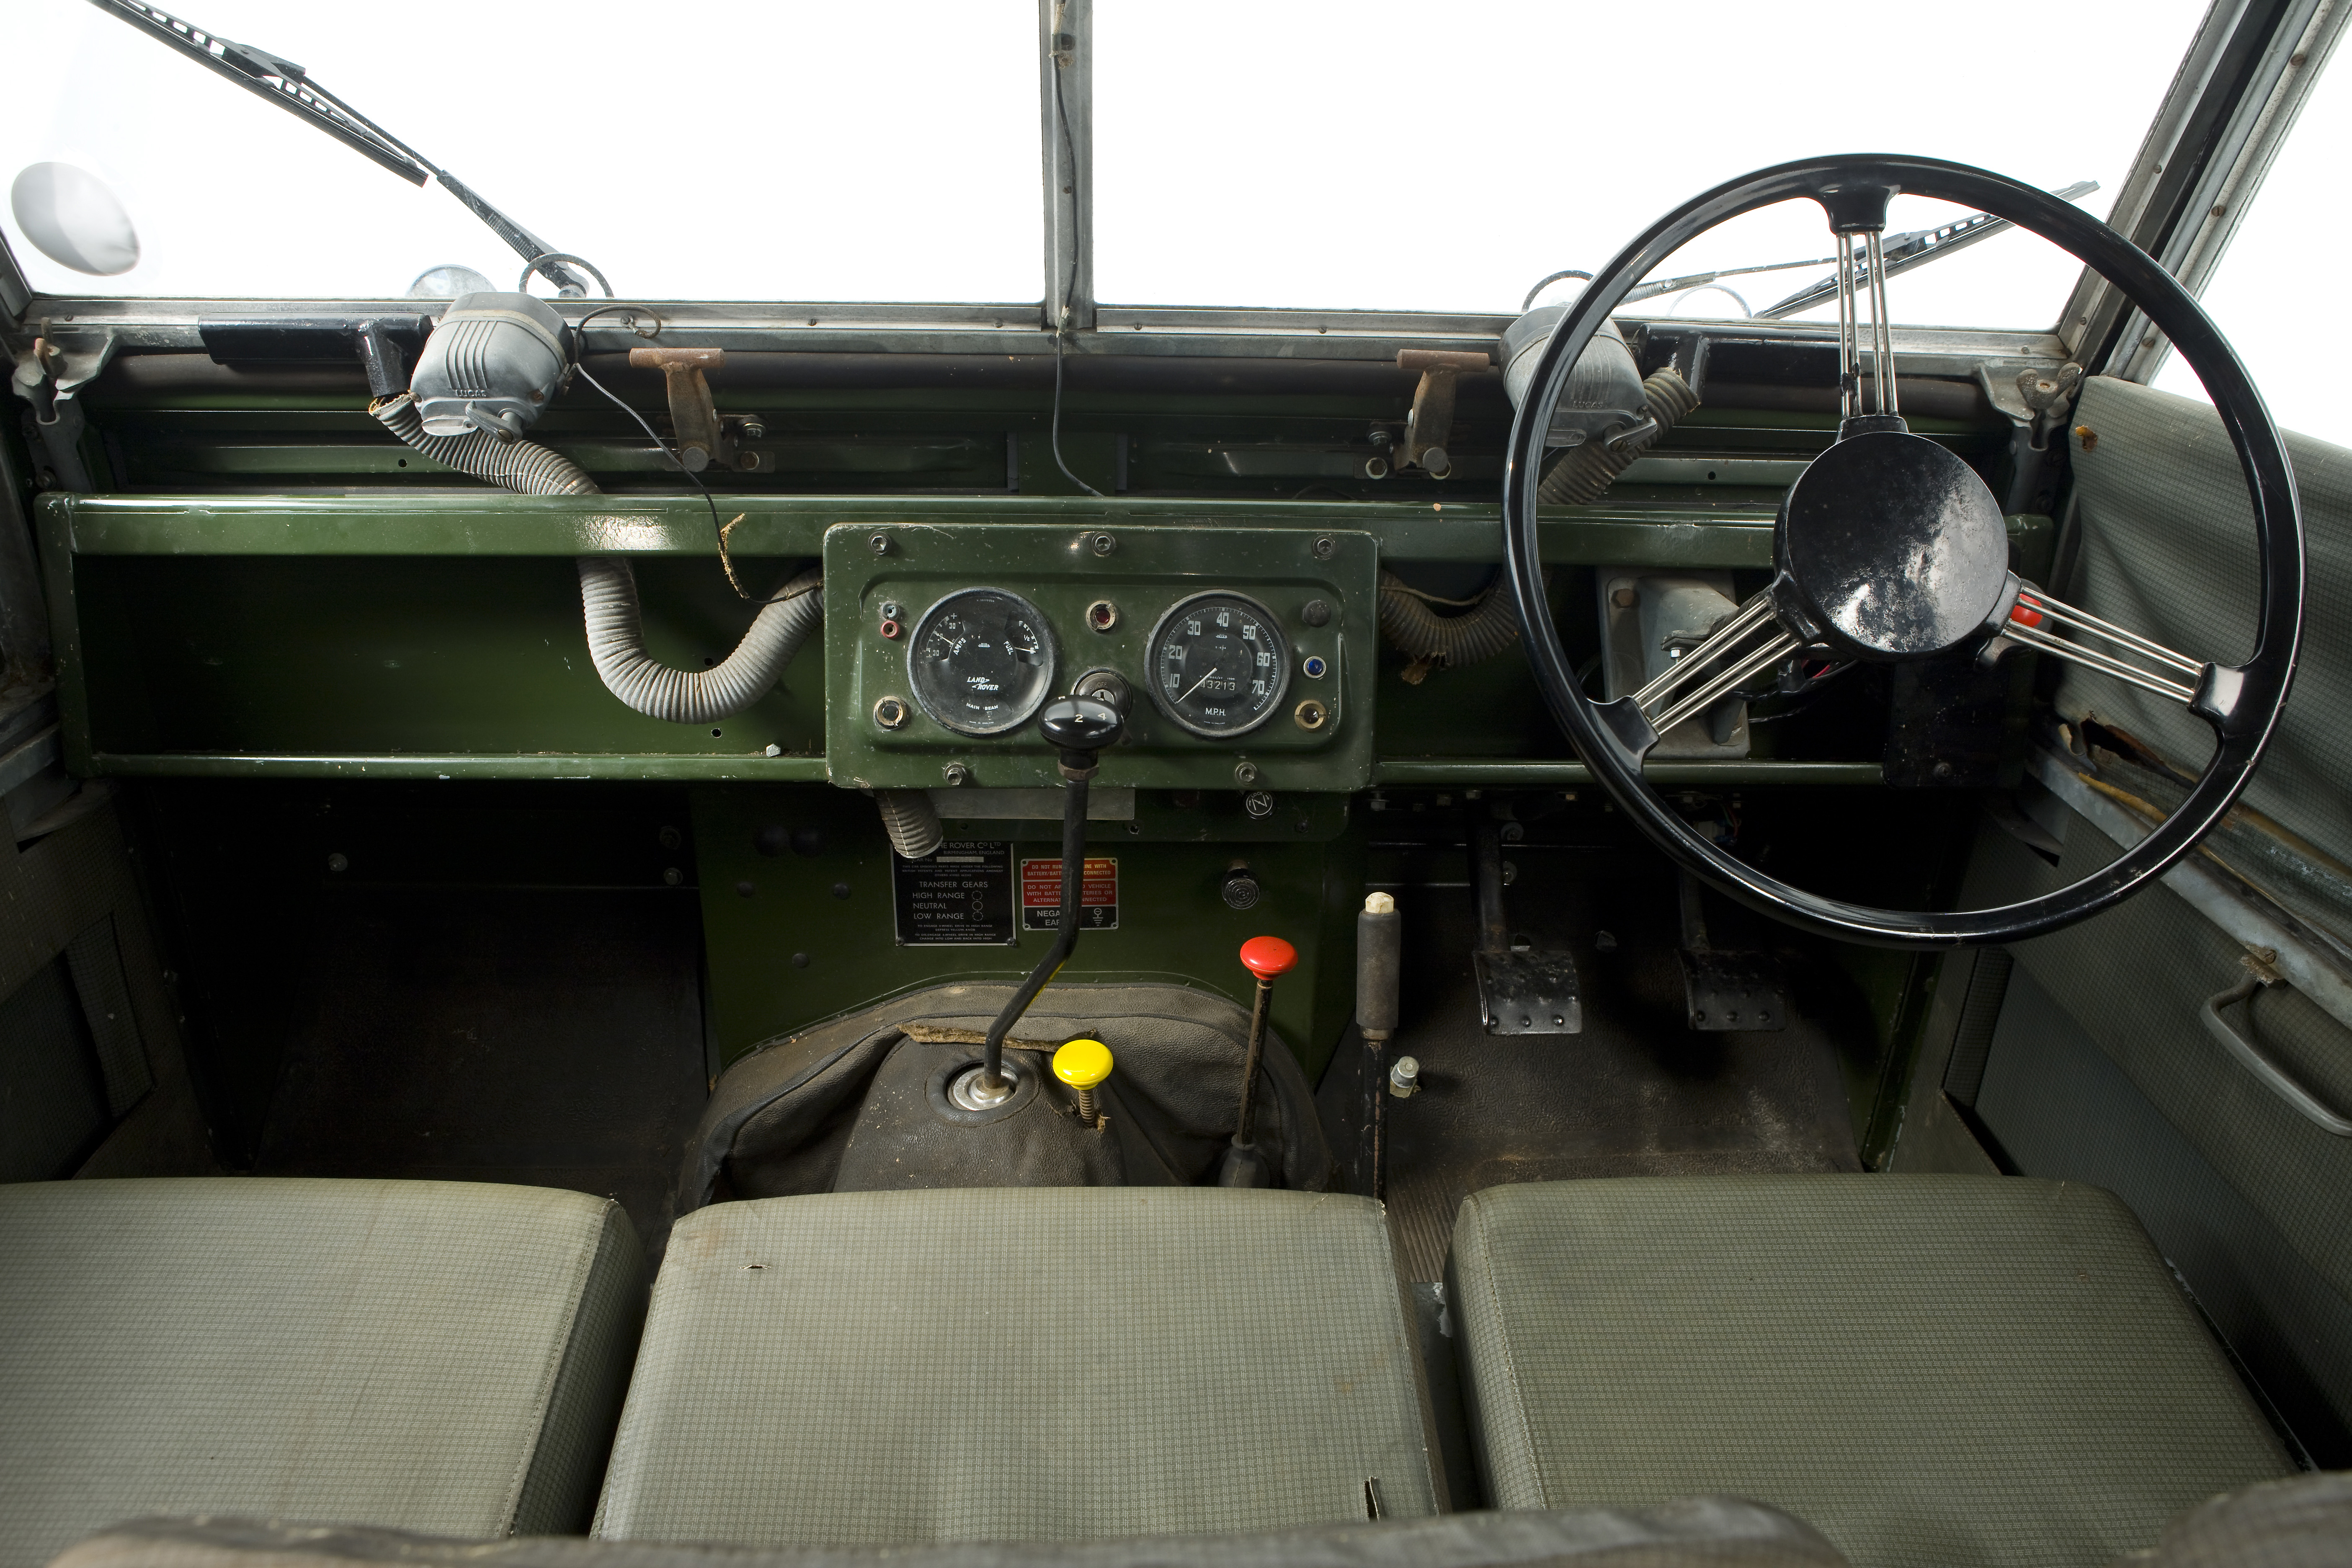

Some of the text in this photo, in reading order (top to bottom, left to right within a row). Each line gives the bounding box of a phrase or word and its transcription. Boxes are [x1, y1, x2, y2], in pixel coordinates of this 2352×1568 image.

[1573, 400, 1603, 409] LUCAS
[1216, 612, 1229, 627] 40
[1188, 620, 1201, 636] 30
[1243, 625, 1256, 640] 50
[953, 637, 967, 655] AMPS
[1003, 641, 1014, 655] FUEL
[1168, 645, 1183, 660] 20
[1257, 652, 1270, 667] 60
[1170, 673, 1180, 688] 10
[1252, 679, 1265, 694] 70
[1074, 714, 1083, 723] 2
[1205, 707, 1226, 716] M.P.H.
